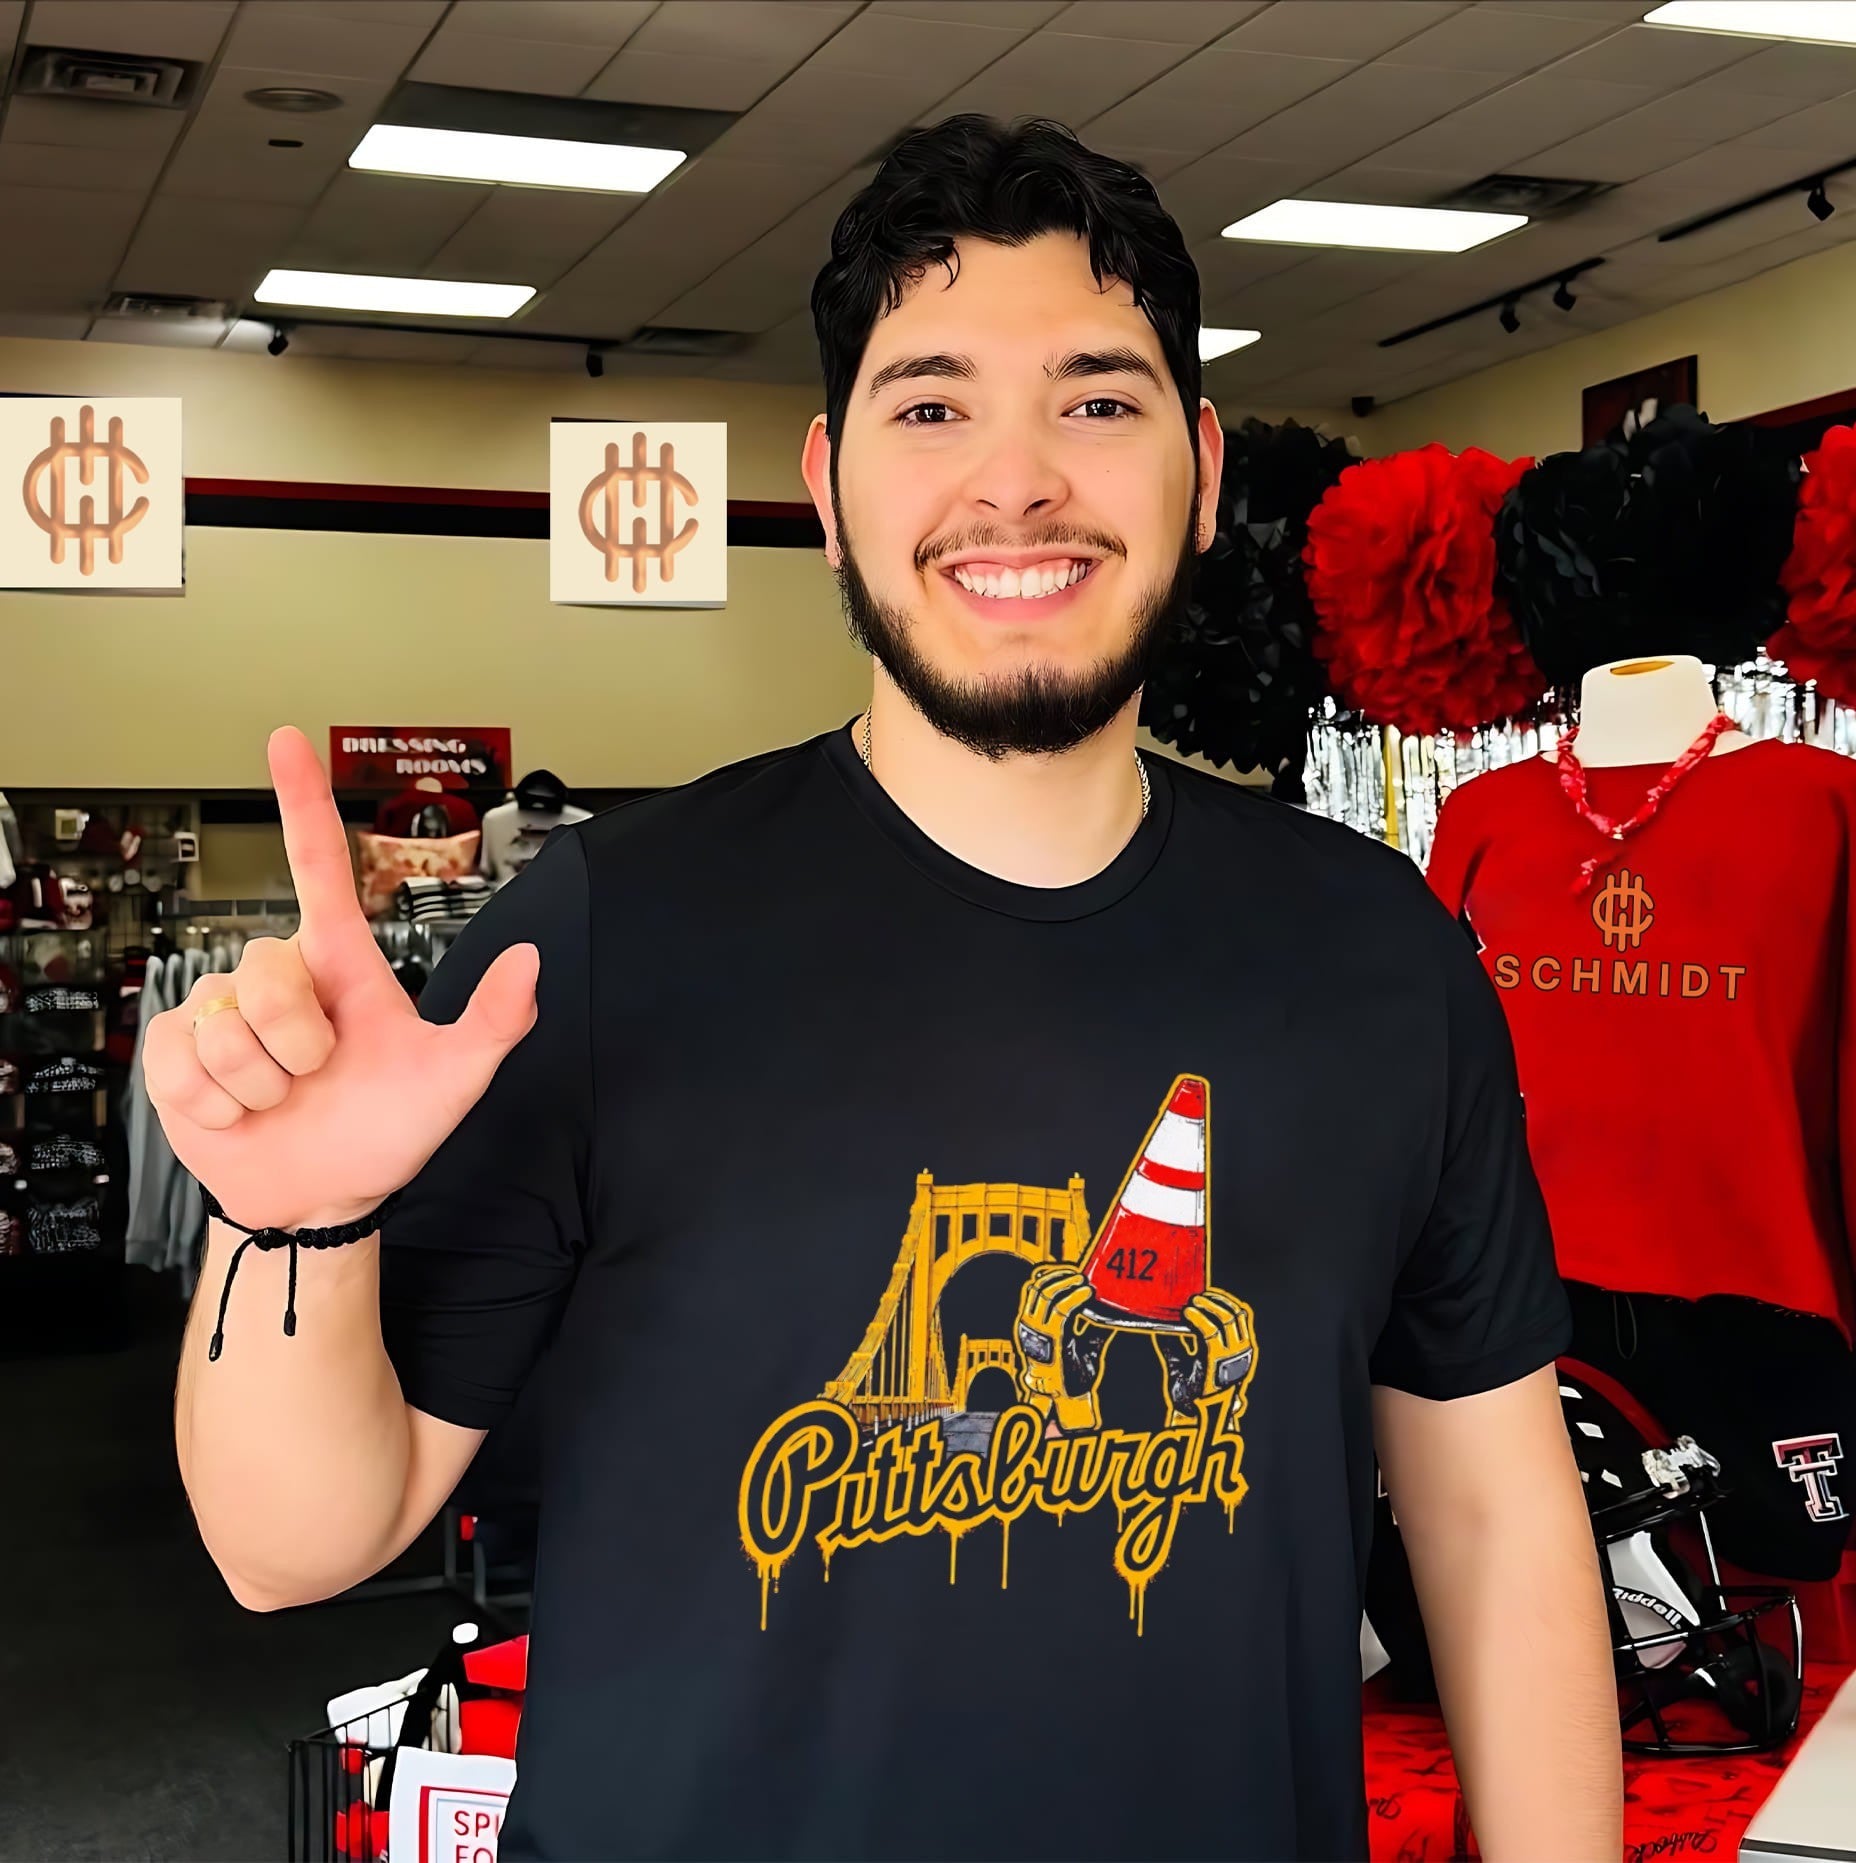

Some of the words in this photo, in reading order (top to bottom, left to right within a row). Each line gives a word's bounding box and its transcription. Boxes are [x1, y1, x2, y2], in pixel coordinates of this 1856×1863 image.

[342, 737, 467, 754] DRESSING
[396, 758, 487, 775] ROOMS
[1493, 953, 1747, 1000] SCHMIDT
[1105, 1247, 1159, 1283] 412
[738, 1397, 1249, 1578] Pittsburgh
